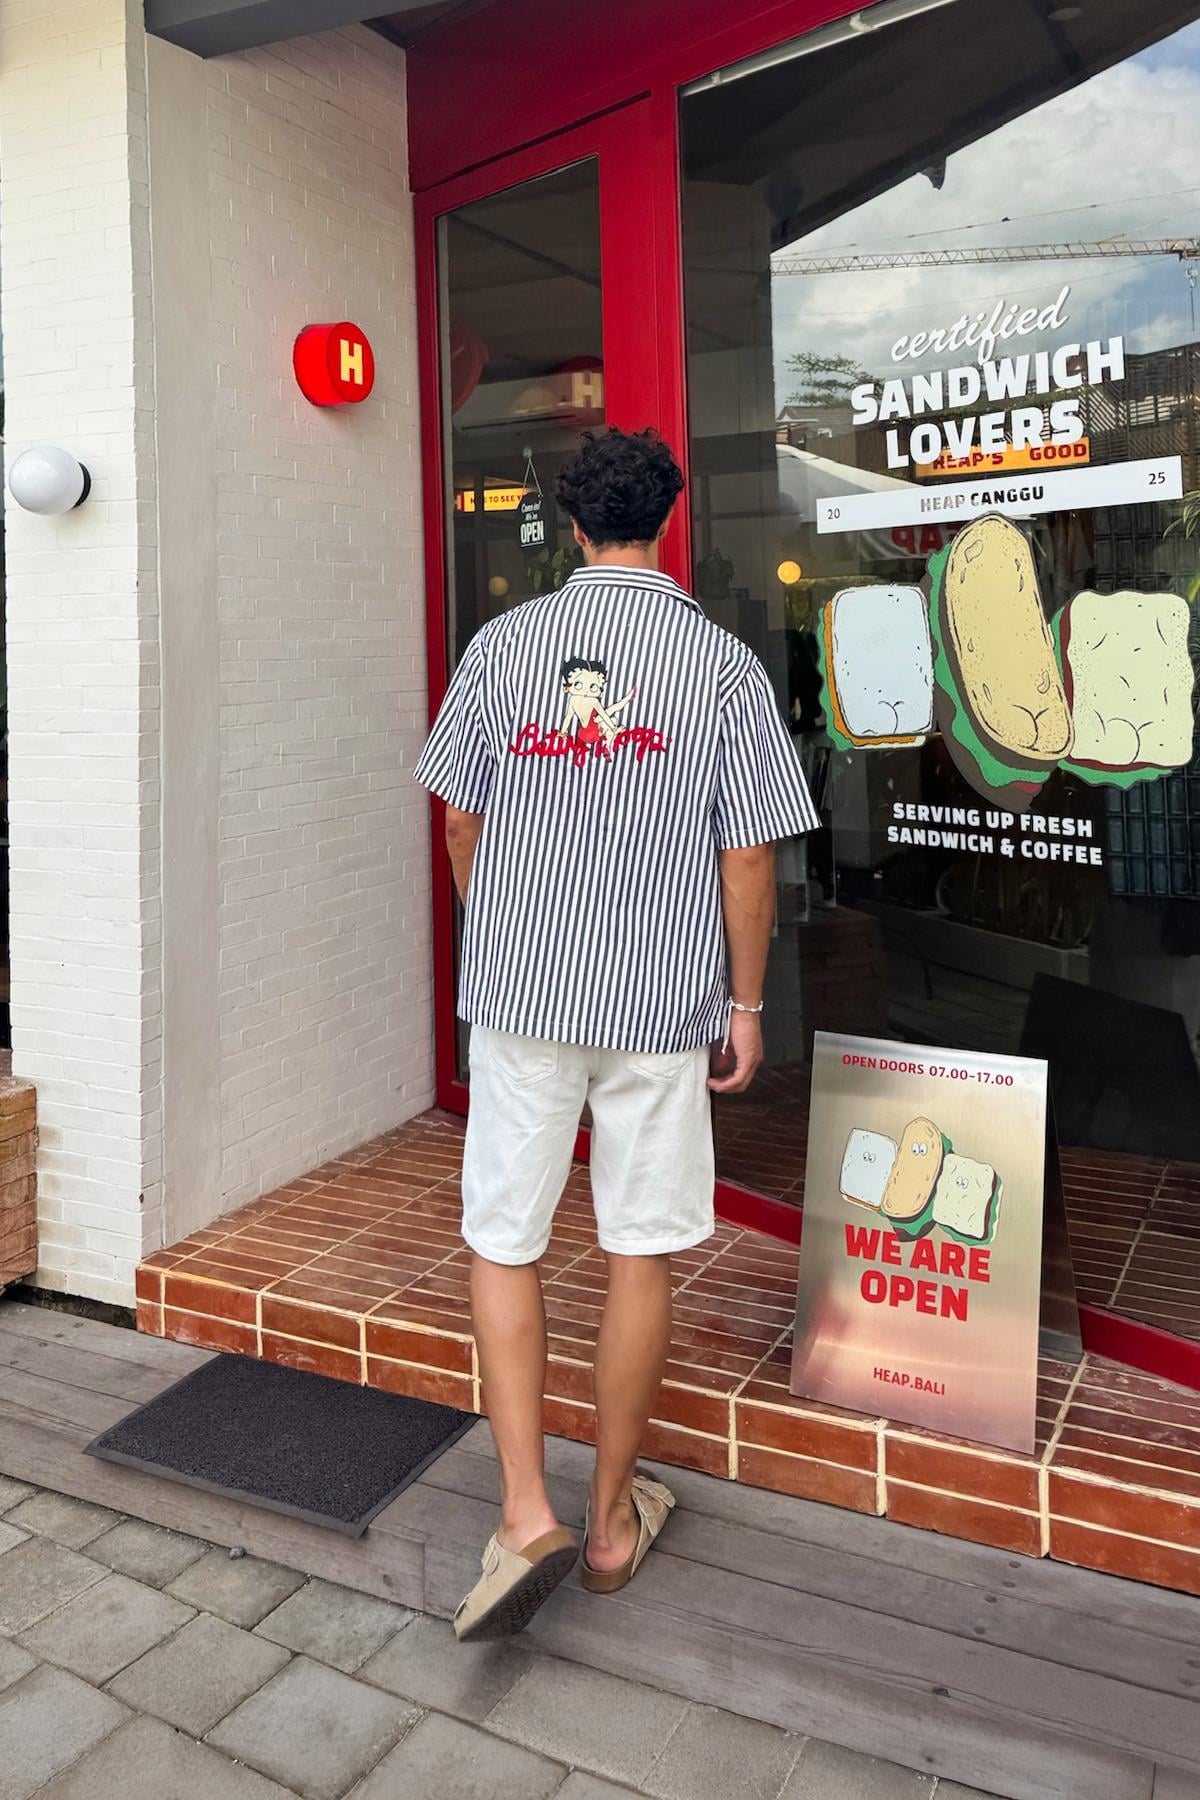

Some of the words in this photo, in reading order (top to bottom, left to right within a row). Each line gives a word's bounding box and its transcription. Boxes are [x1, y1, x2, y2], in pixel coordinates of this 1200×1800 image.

[890, 286, 1072, 362] certified
[340, 338, 364, 386] H
[850, 336, 1126, 426] SANDWICH
[886, 400, 1085, 469] LOVERS
[1029, 443, 1088, 461] GOOD
[827, 507, 841, 521] 20
[920, 495, 965, 513] HEAP
[970, 485, 1045, 507] CANGGU
[1147, 471, 1167, 486] 25
[520, 520, 545, 544] OPEN
[892, 802, 980, 827] SERVING
[985, 811, 1015, 830] UP
[1020, 813, 1094, 838] FRESH
[887, 825, 995, 854] SANDWICH
[999, 837, 1016, 859] &
[1020, 839, 1104, 866] COFFEE
[842, 1054, 877, 1069] OPEN
[879, 1058, 925, 1076] DOORS
[928, 1065, 1014, 1087] 07.00-17.00
[844, 1222, 903, 1266] WE
[909, 1238, 992, 1284] ARE
[859, 1269, 969, 1323] OPEN
[872, 1366, 946, 1396] HEAP.BALI
